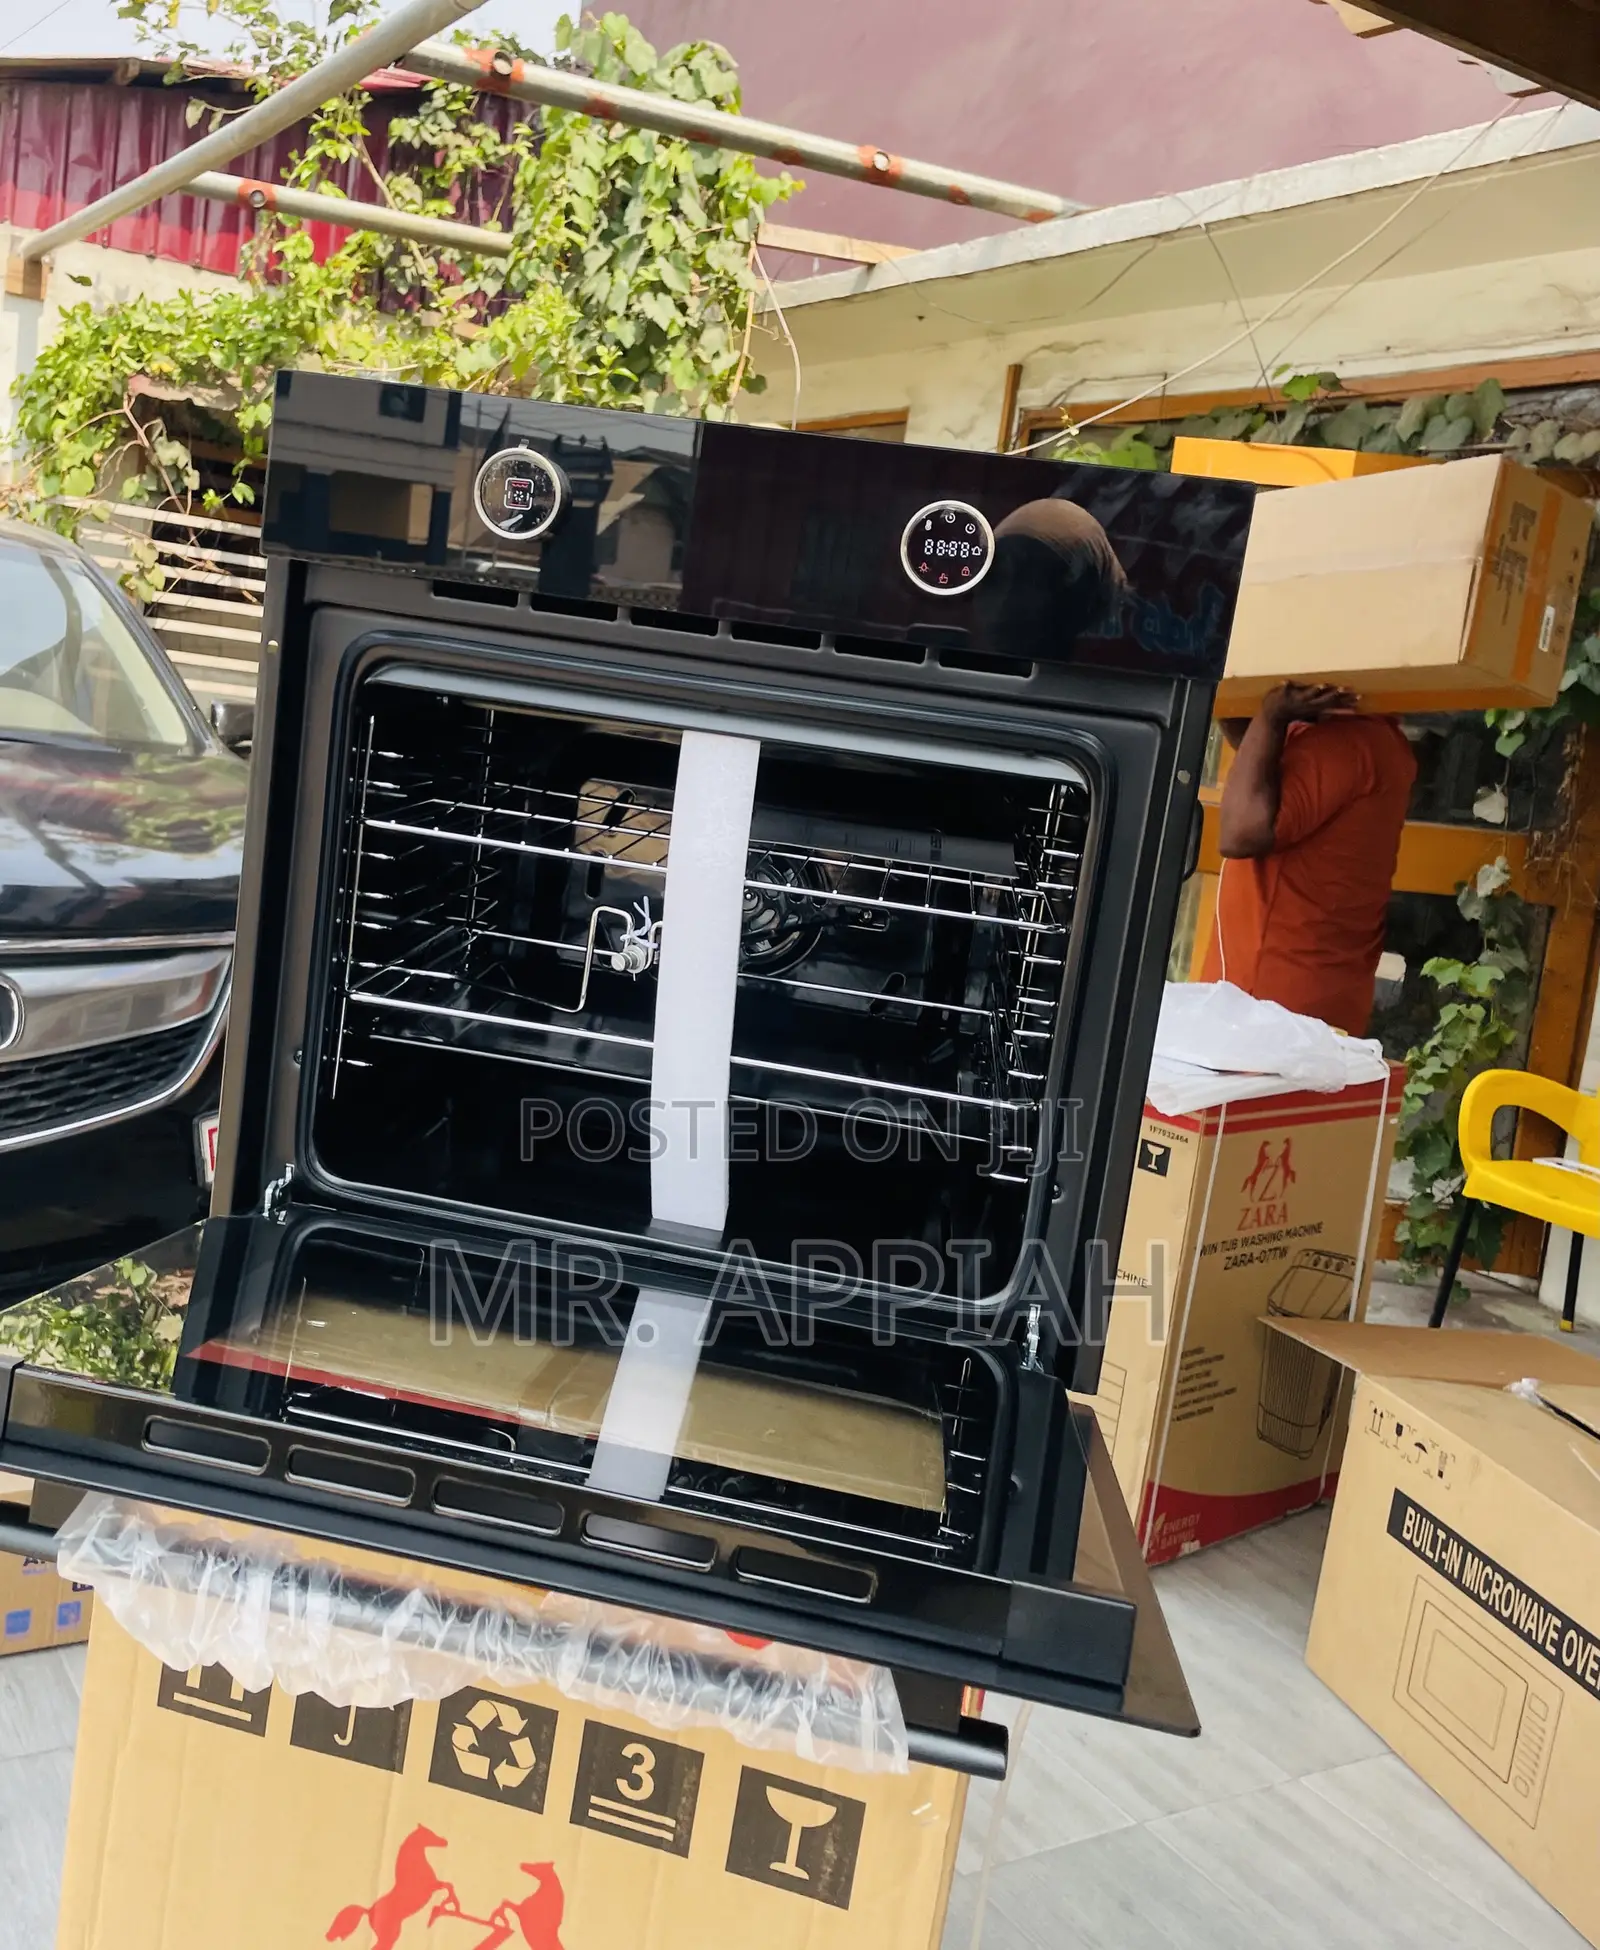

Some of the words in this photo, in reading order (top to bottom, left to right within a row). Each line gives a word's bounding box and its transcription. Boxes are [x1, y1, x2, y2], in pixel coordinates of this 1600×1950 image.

[1220, 1239, 1239, 1253] TUB
[1241, 1229, 1284, 1248] WASHING
[1284, 1220, 1324, 1239] MACHINE
[1237, 1202, 1288, 1231] ZARA
[1402, 1505, 1464, 1579] BUILT-IN
[1461, 1551, 1562, 1656] MICROWAVE
[1562, 1628, 1600, 1691] OVE
[616, 1742, 656, 1801] 3
